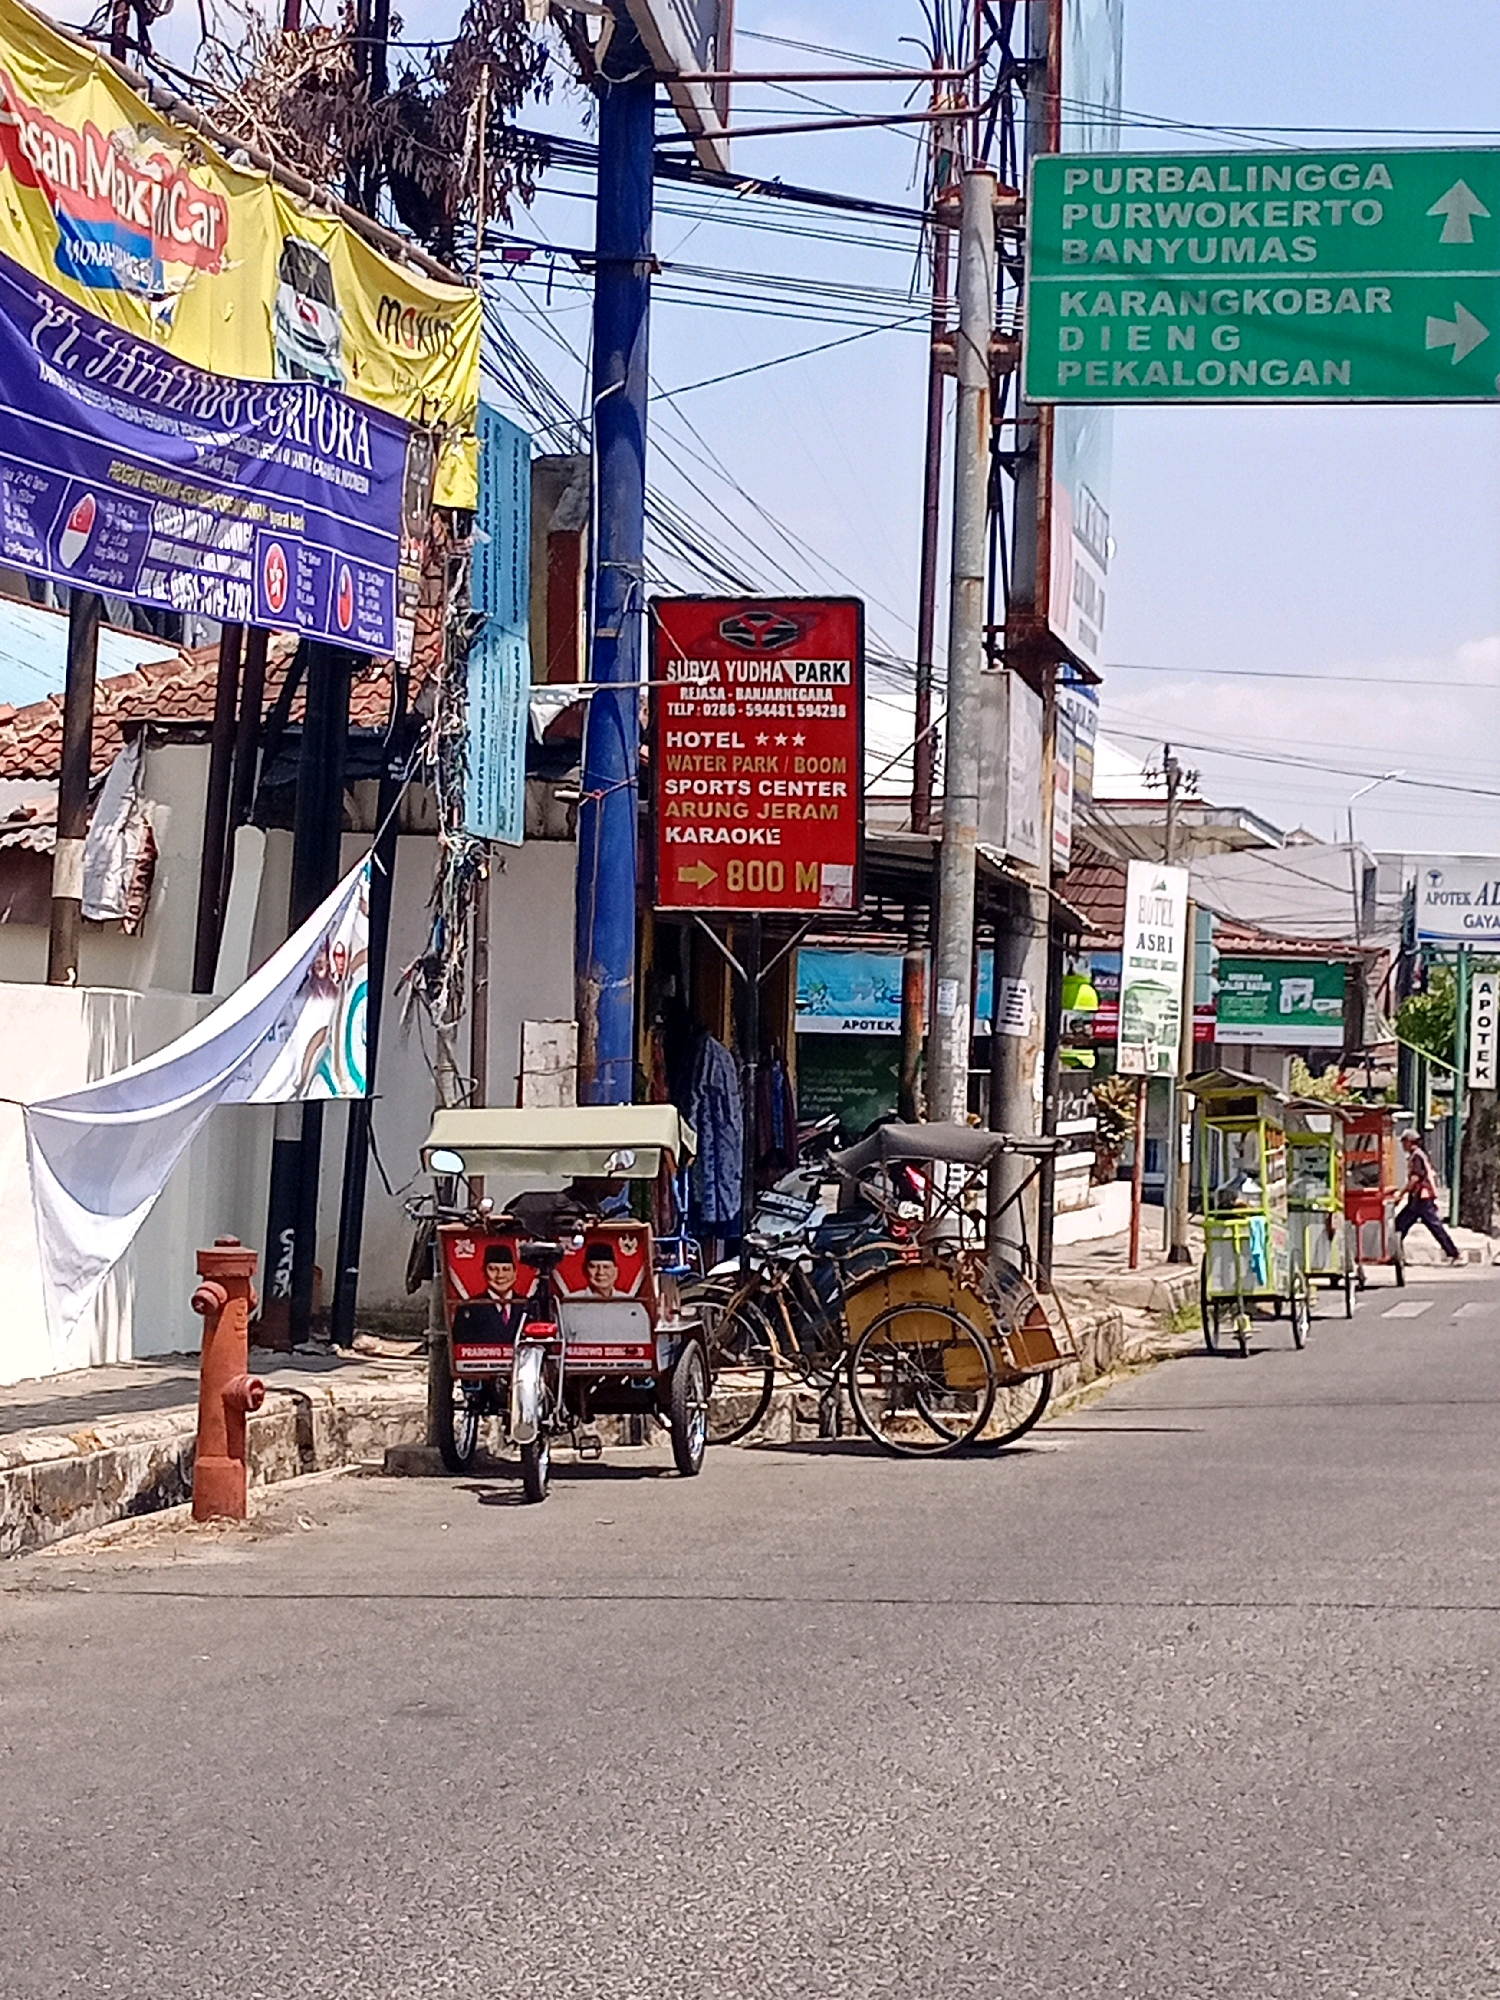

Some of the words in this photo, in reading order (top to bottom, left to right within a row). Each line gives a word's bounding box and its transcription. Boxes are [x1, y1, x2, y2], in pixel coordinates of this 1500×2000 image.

[1063, 163, 1393, 194] PURBALINGGA
[1062, 199, 1383, 229] PURWOKERTO
[1062, 236, 1317, 264] BANYUMAS
[1060, 287, 1393, 317] KARANGKOBAR
[31, 290, 81, 371] PT.
[1058, 360, 1351, 387] PEKALONGAN
[667, 660, 720, 683] SURYA
[725, 660, 784, 683] YUDHA
[795, 662, 846, 683] PARK
[680, 687, 726, 700] REJASA
[736, 687, 833, 701] BANJARNEGARA
[703, 703, 736, 716] 0286
[797, 704, 846, 718] 594298
[666, 731, 745, 748] HOTEL
[666, 755, 727, 773] WATER
[732, 756, 778, 773] PARK
[794, 757, 846, 774] BOOM
[665, 779, 751, 795] SPORTS
[758, 780, 847, 797] CENTER
[664, 801, 749, 819] ARUNG
[757, 803, 839, 820] JERAM
[665, 827, 781, 845] KARAOKE
[727, 859, 784, 892] 800
[795, 861, 818, 893] M
[1424, 892, 1472, 906] APOTEK
[1136, 932, 1173, 954] ASRI
[842, 1020, 895, 1031] APOTEK
[1476, 982, 1492, 1079] APOTEK
[566, 1346, 602, 1357] RABOWO
